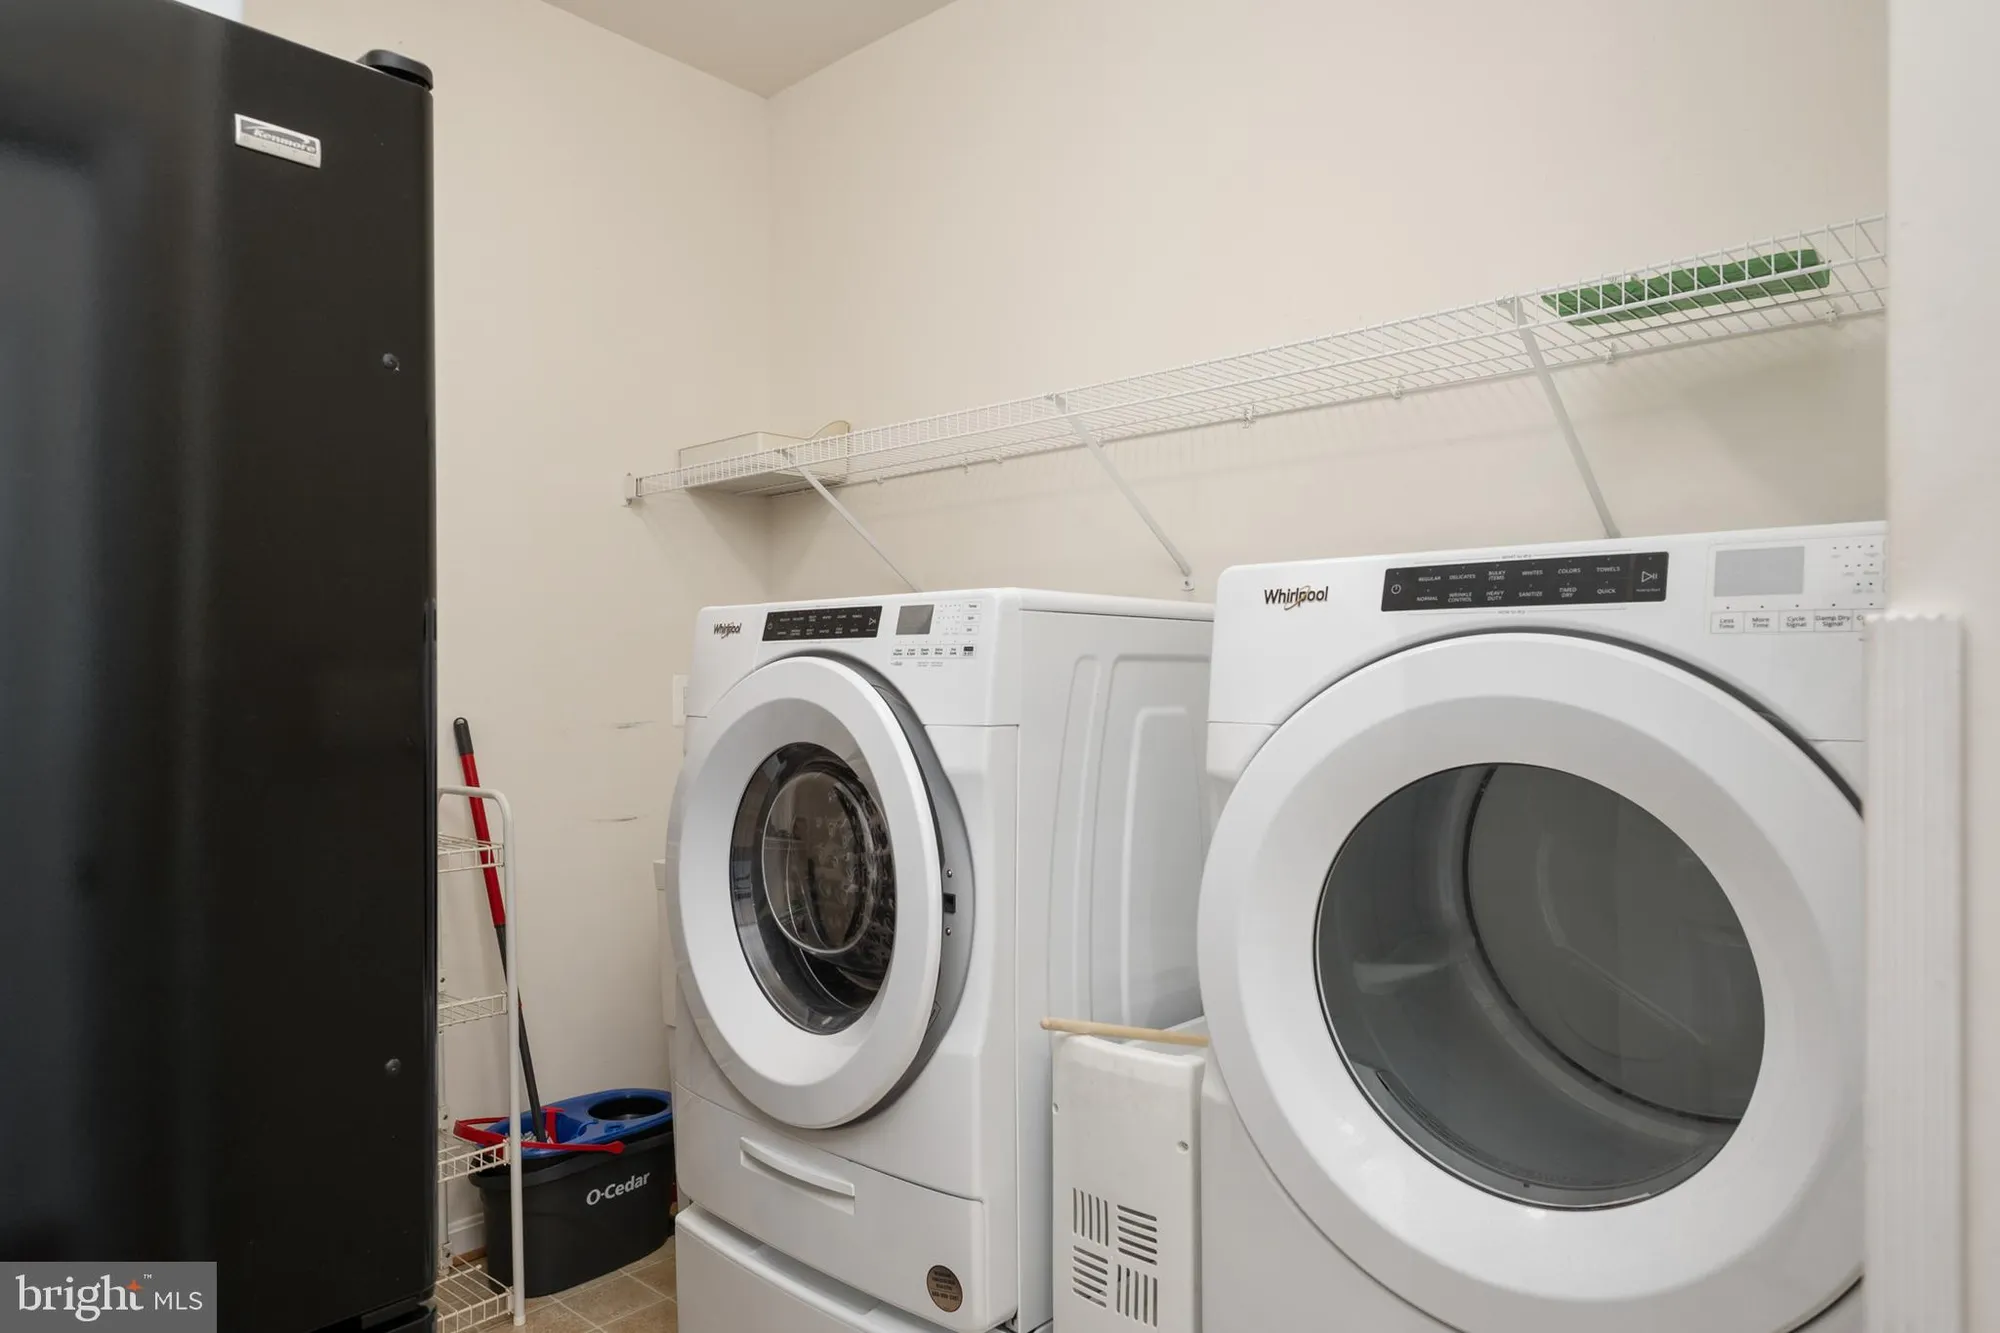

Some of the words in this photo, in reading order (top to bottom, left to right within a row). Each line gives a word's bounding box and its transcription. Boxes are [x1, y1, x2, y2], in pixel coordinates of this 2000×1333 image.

[253, 128, 317, 154] Kenmore
[1557, 567, 1581, 575] COLORS
[1264, 585, 1329, 610] Whirlpool
[1787, 615, 1805, 623] Cycle
[1838, 614, 1851, 622] Dry
[1786, 621, 1807, 629] Signal
[1822, 620, 1844, 628] Signal
[713, 622, 743, 639] Whirlpool
[586, 1172, 651, 1206] O-Cedar
